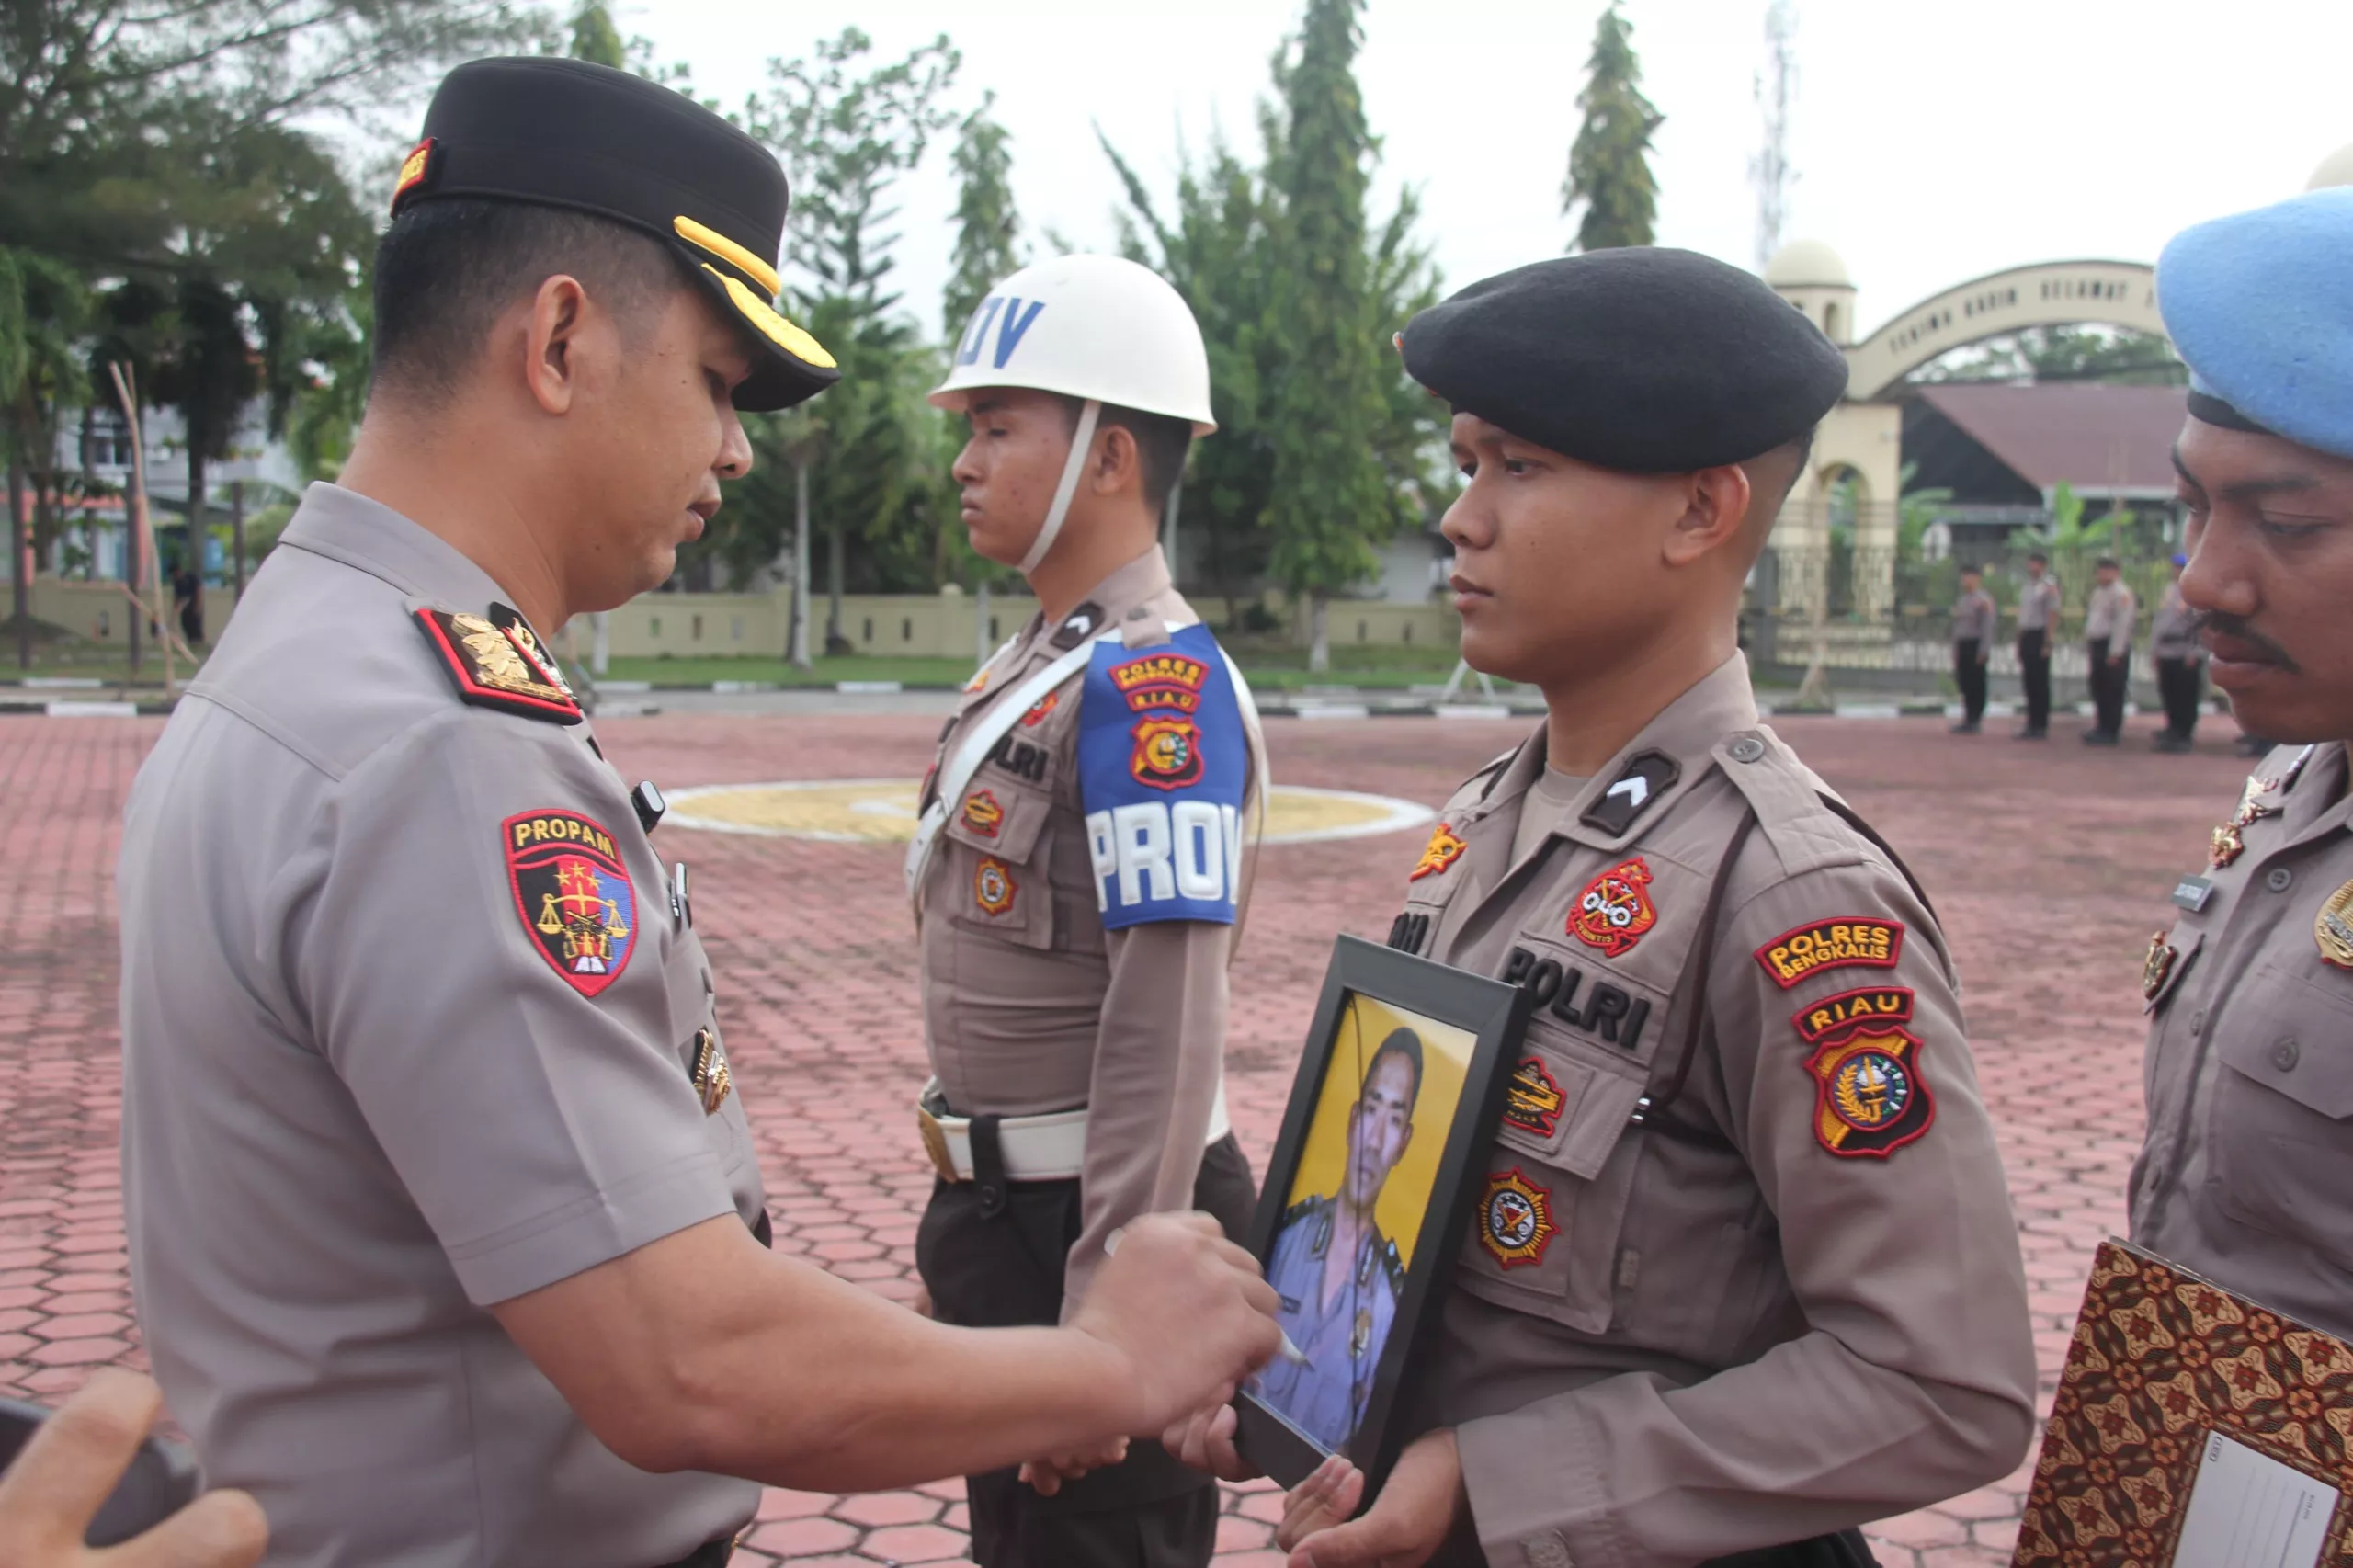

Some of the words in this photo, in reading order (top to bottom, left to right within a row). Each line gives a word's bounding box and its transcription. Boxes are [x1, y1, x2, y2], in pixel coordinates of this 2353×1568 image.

[1134, 691, 1192, 707] RIAU
[515, 818, 616, 859] PROPAM
[1768, 926, 1890, 969] POLRES
[1779, 943, 1888, 979] BENGKALIS
[1502, 946, 1652, 1050] POLRI
[1810, 994, 1900, 1030] RIAU
